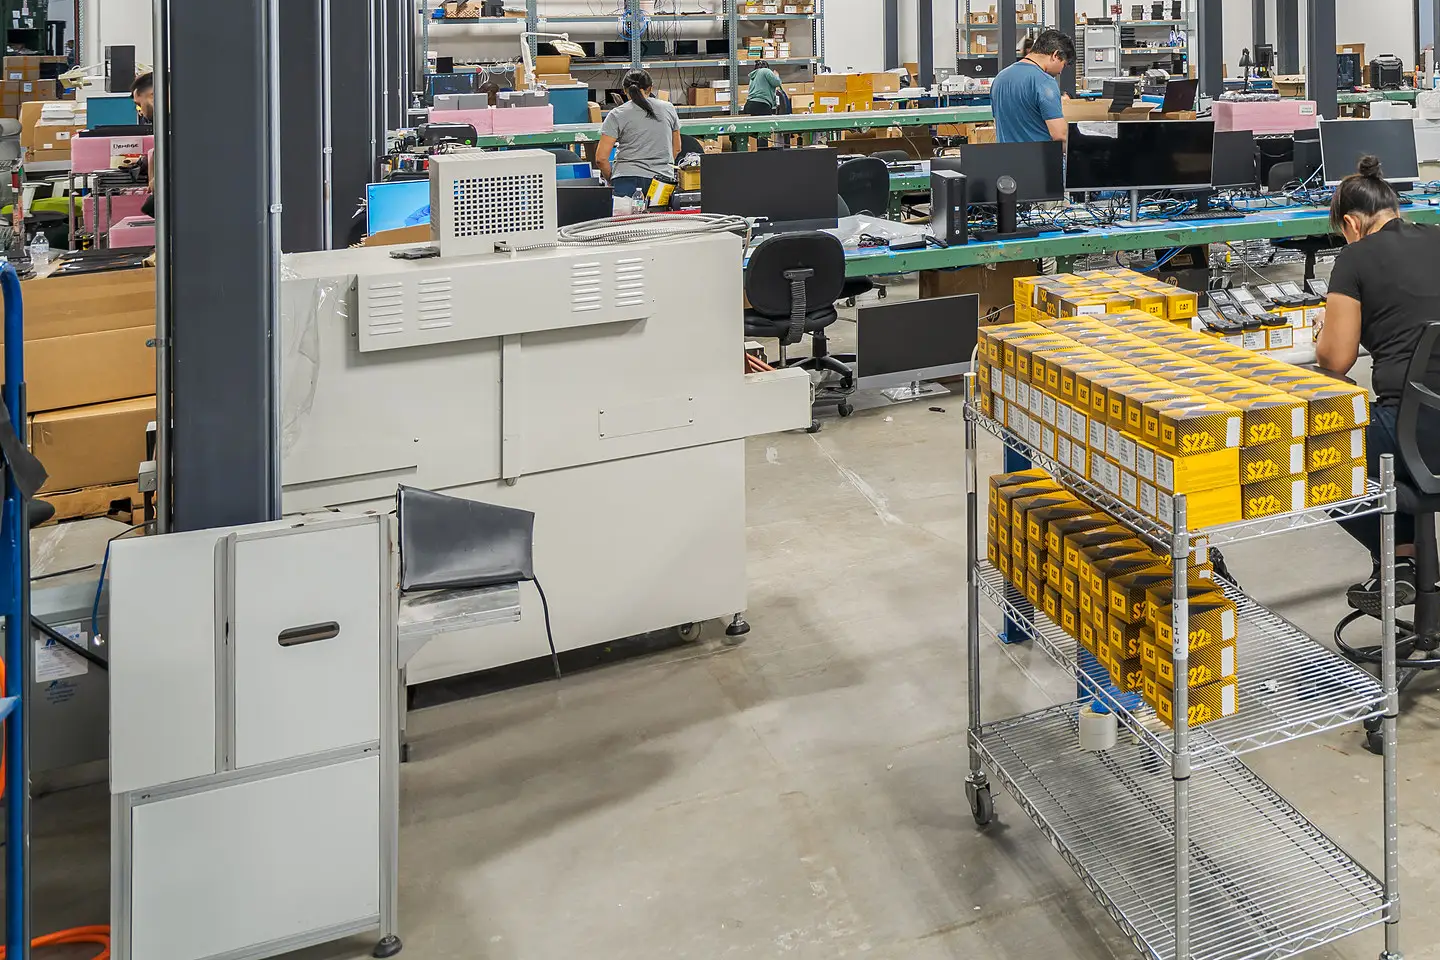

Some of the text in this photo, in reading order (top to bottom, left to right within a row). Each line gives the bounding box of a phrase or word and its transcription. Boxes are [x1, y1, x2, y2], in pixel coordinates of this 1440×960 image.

[1314, 410, 1339, 431] S22
[1181, 431, 1209, 453] S22
[1250, 422, 1275, 443] S22
[1312, 447, 1337, 468] S22
[1247, 459, 1273, 481] S22
[1311, 482, 1337, 504] S22
[1248, 494, 1275, 516] S22
